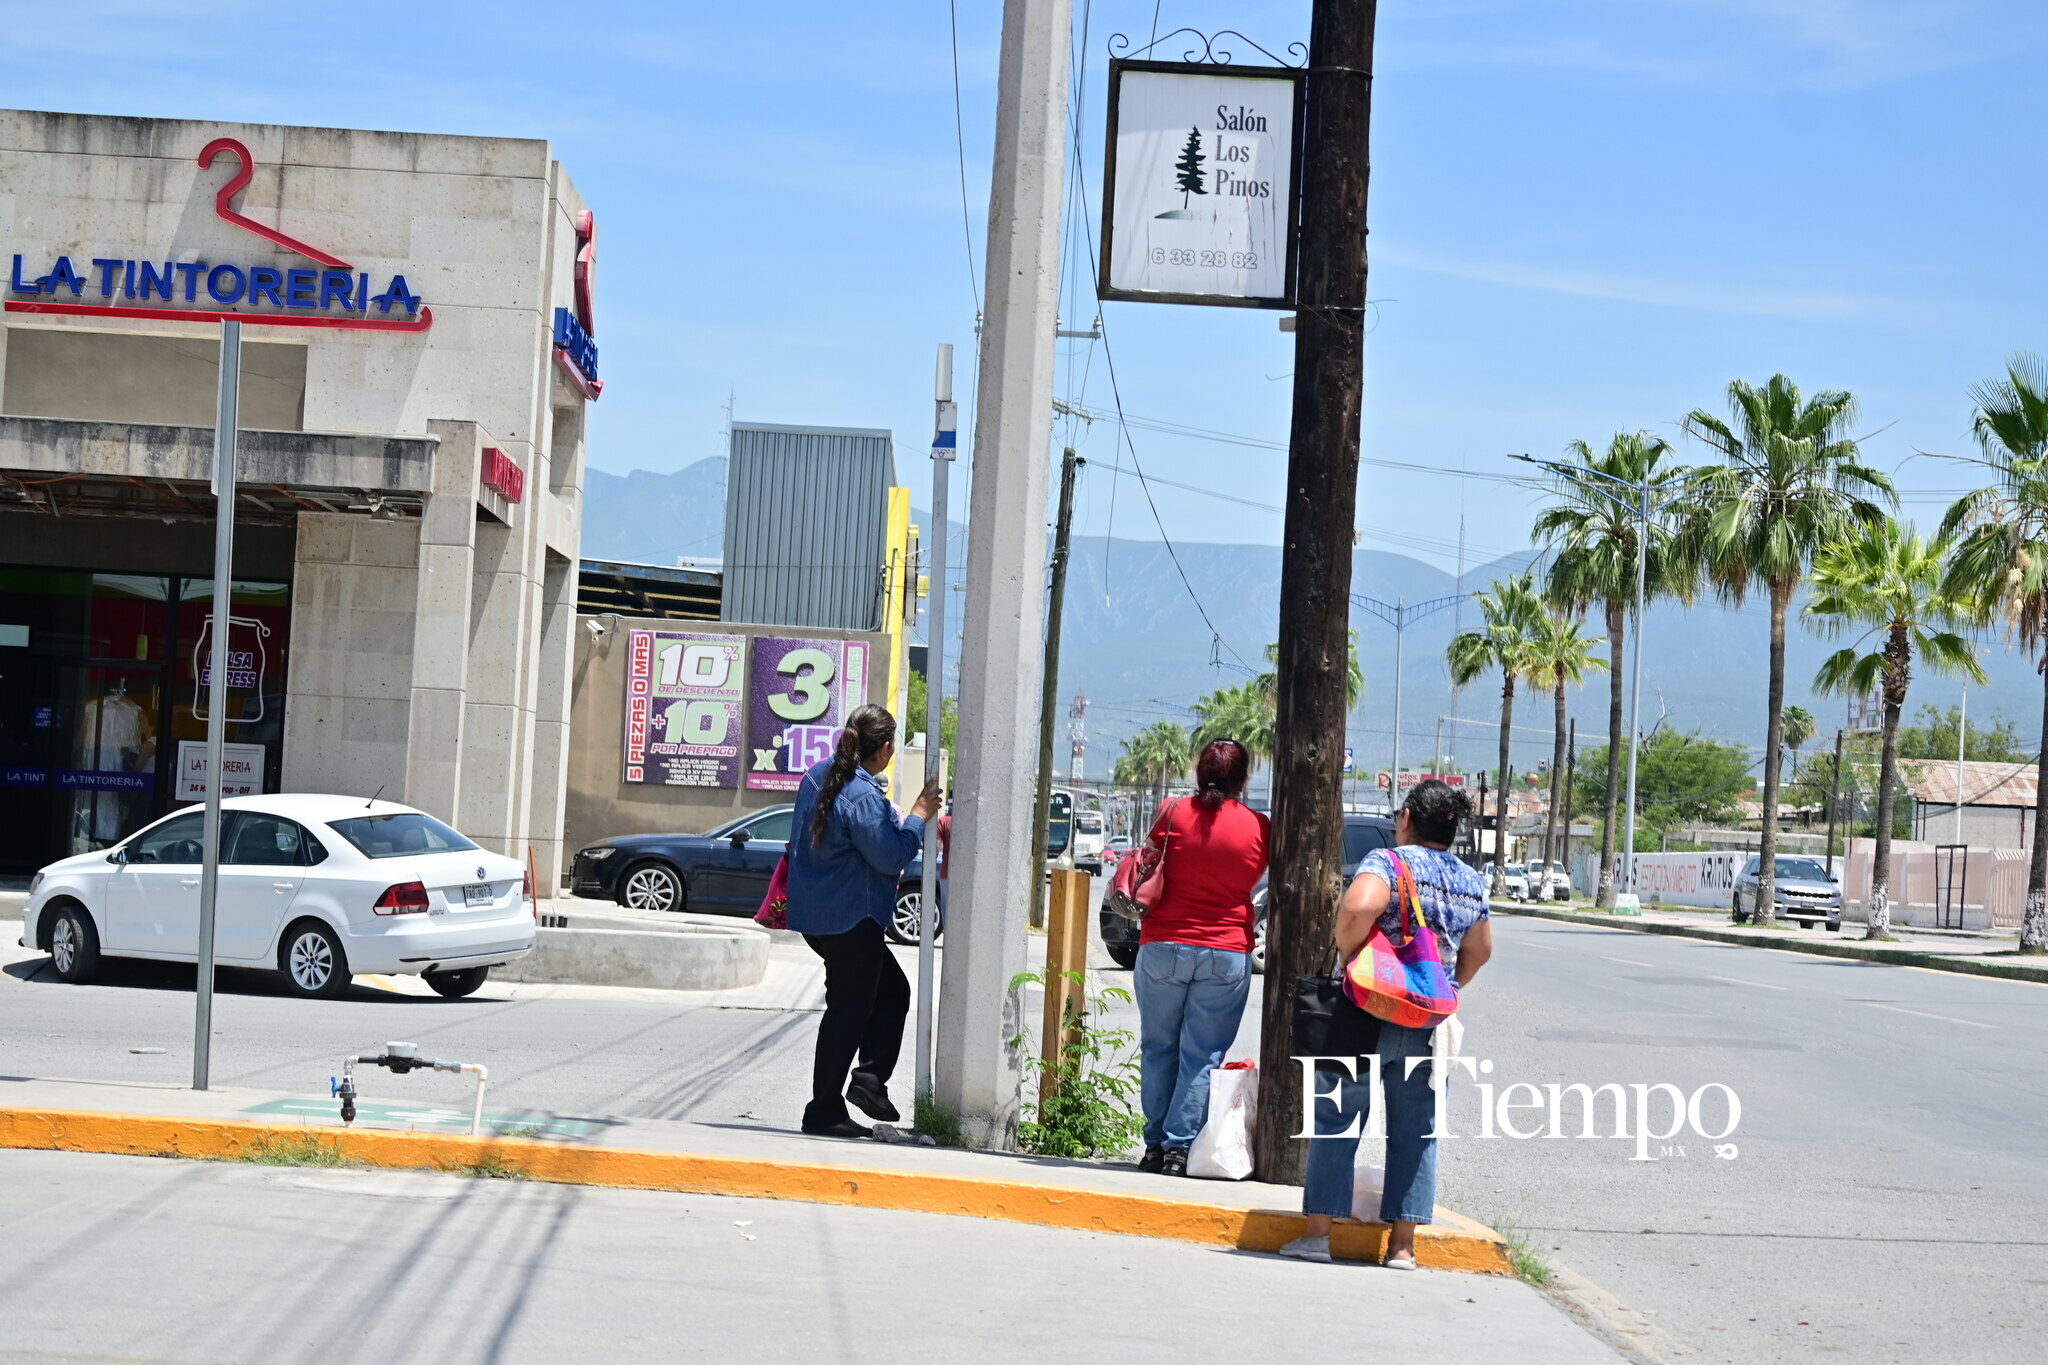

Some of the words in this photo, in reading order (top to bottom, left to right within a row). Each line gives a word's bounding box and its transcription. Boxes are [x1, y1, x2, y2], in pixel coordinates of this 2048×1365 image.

[1216, 104, 1267, 133] Salón
[1215, 134, 1250, 163] Los
[1215, 168, 1270, 198] Pinos
[1152, 248, 1165, 265] 6
[1170, 249, 1196, 266] 33
[1200, 250, 1226, 268] 28
[1232, 252, 1257, 270] 82
[11, 253, 87, 296] LA
[92, 258, 422, 315] TINTORERIA
[634, 635, 649, 675] MAS
[633, 680, 647, 693] O
[658, 685, 672, 693] DE
[675, 686, 740, 697] DESCUENTO
[767, 648, 835, 721] 3
[630, 698, 646, 762] PIEZAS
[651, 743, 677, 754] POR
[679, 744, 737, 757] PREPAGO
[7, 772, 20, 781] LA
[192, 759, 201, 771] LA
[629, 767, 643, 780] 5
[62, 775, 76, 784] LA
[79, 775, 144, 787] TINTORERIA
[1701, 857, 1733, 889] KRATUS
